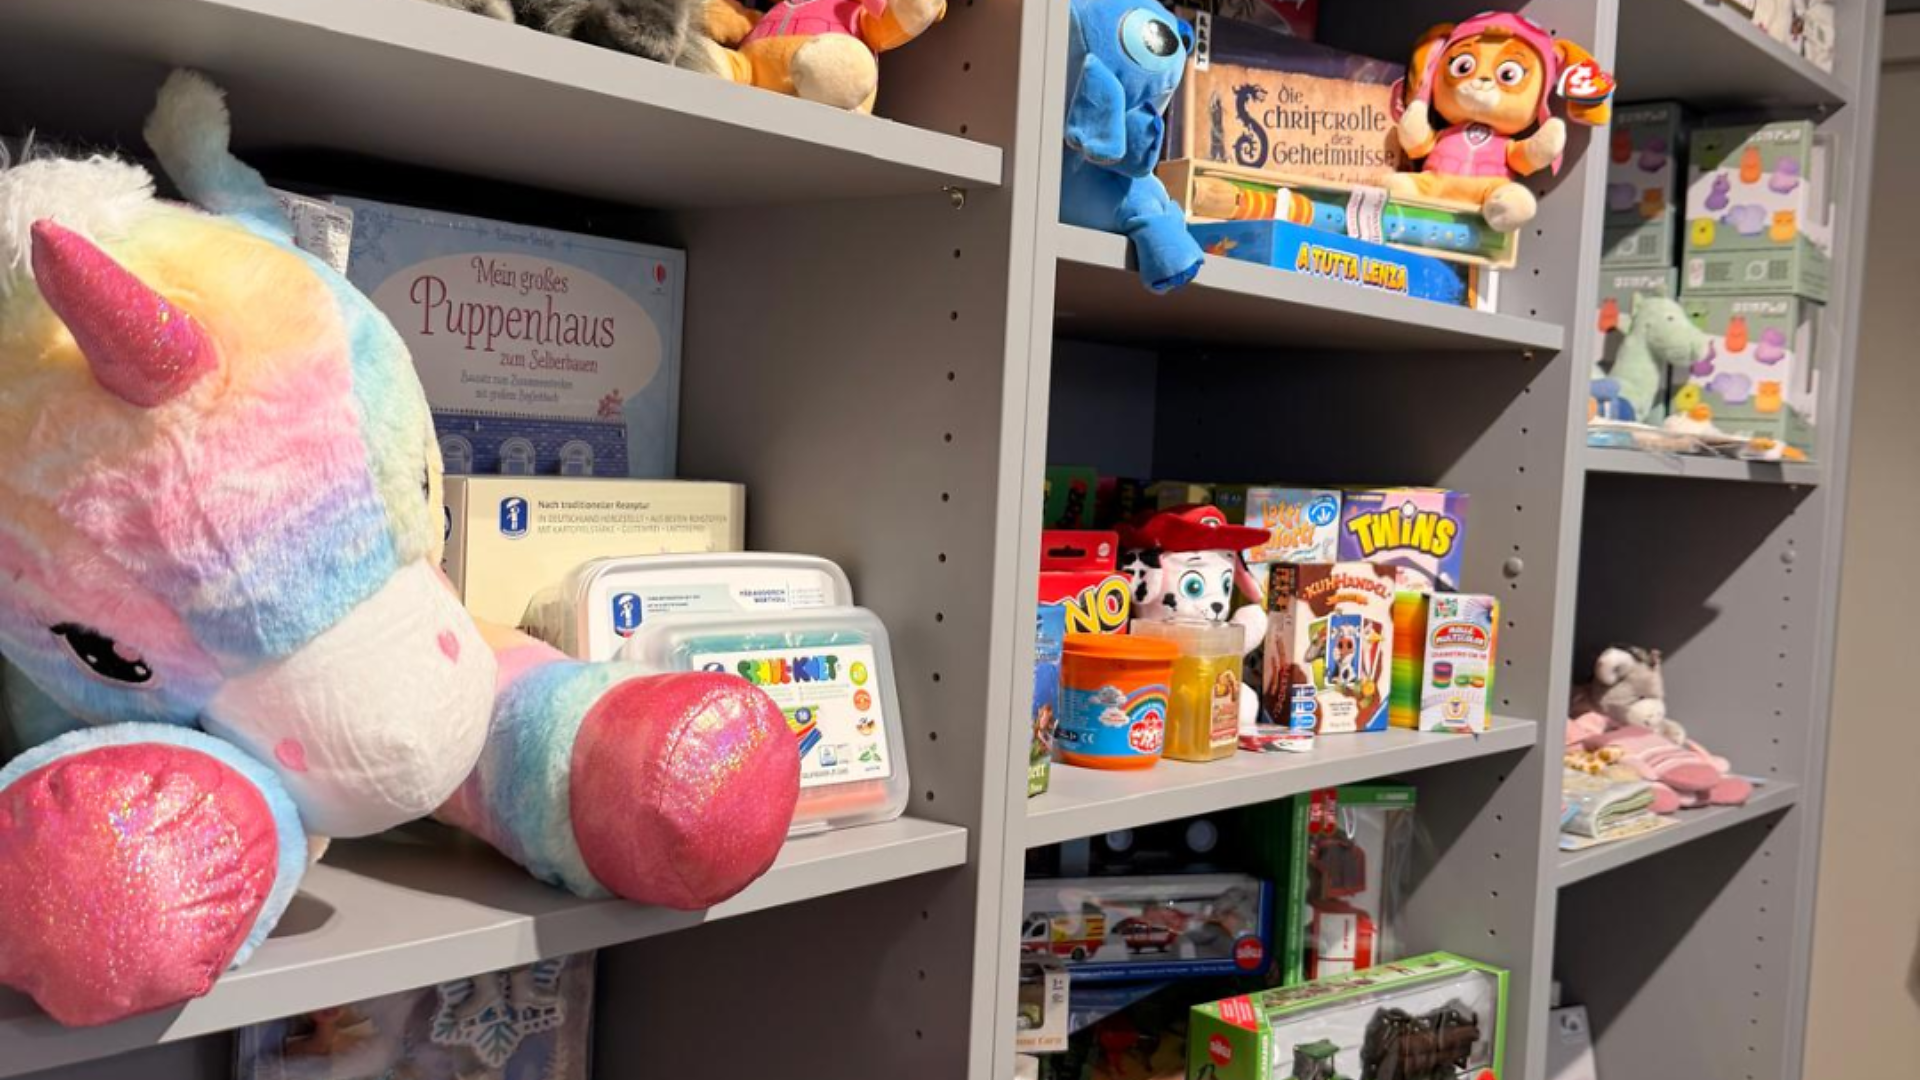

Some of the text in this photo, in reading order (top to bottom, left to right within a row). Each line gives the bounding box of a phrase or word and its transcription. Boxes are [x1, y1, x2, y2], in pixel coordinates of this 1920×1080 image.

[471, 256, 568, 295] Mein großes
[1296, 243, 1408, 293] A TUTTA LENZA
[410, 275, 615, 352] Puppenhaus
[500, 349, 598, 374] zum Selberbauen
[538, 500, 560, 509] Nach
[1064, 577, 1132, 634] NO
